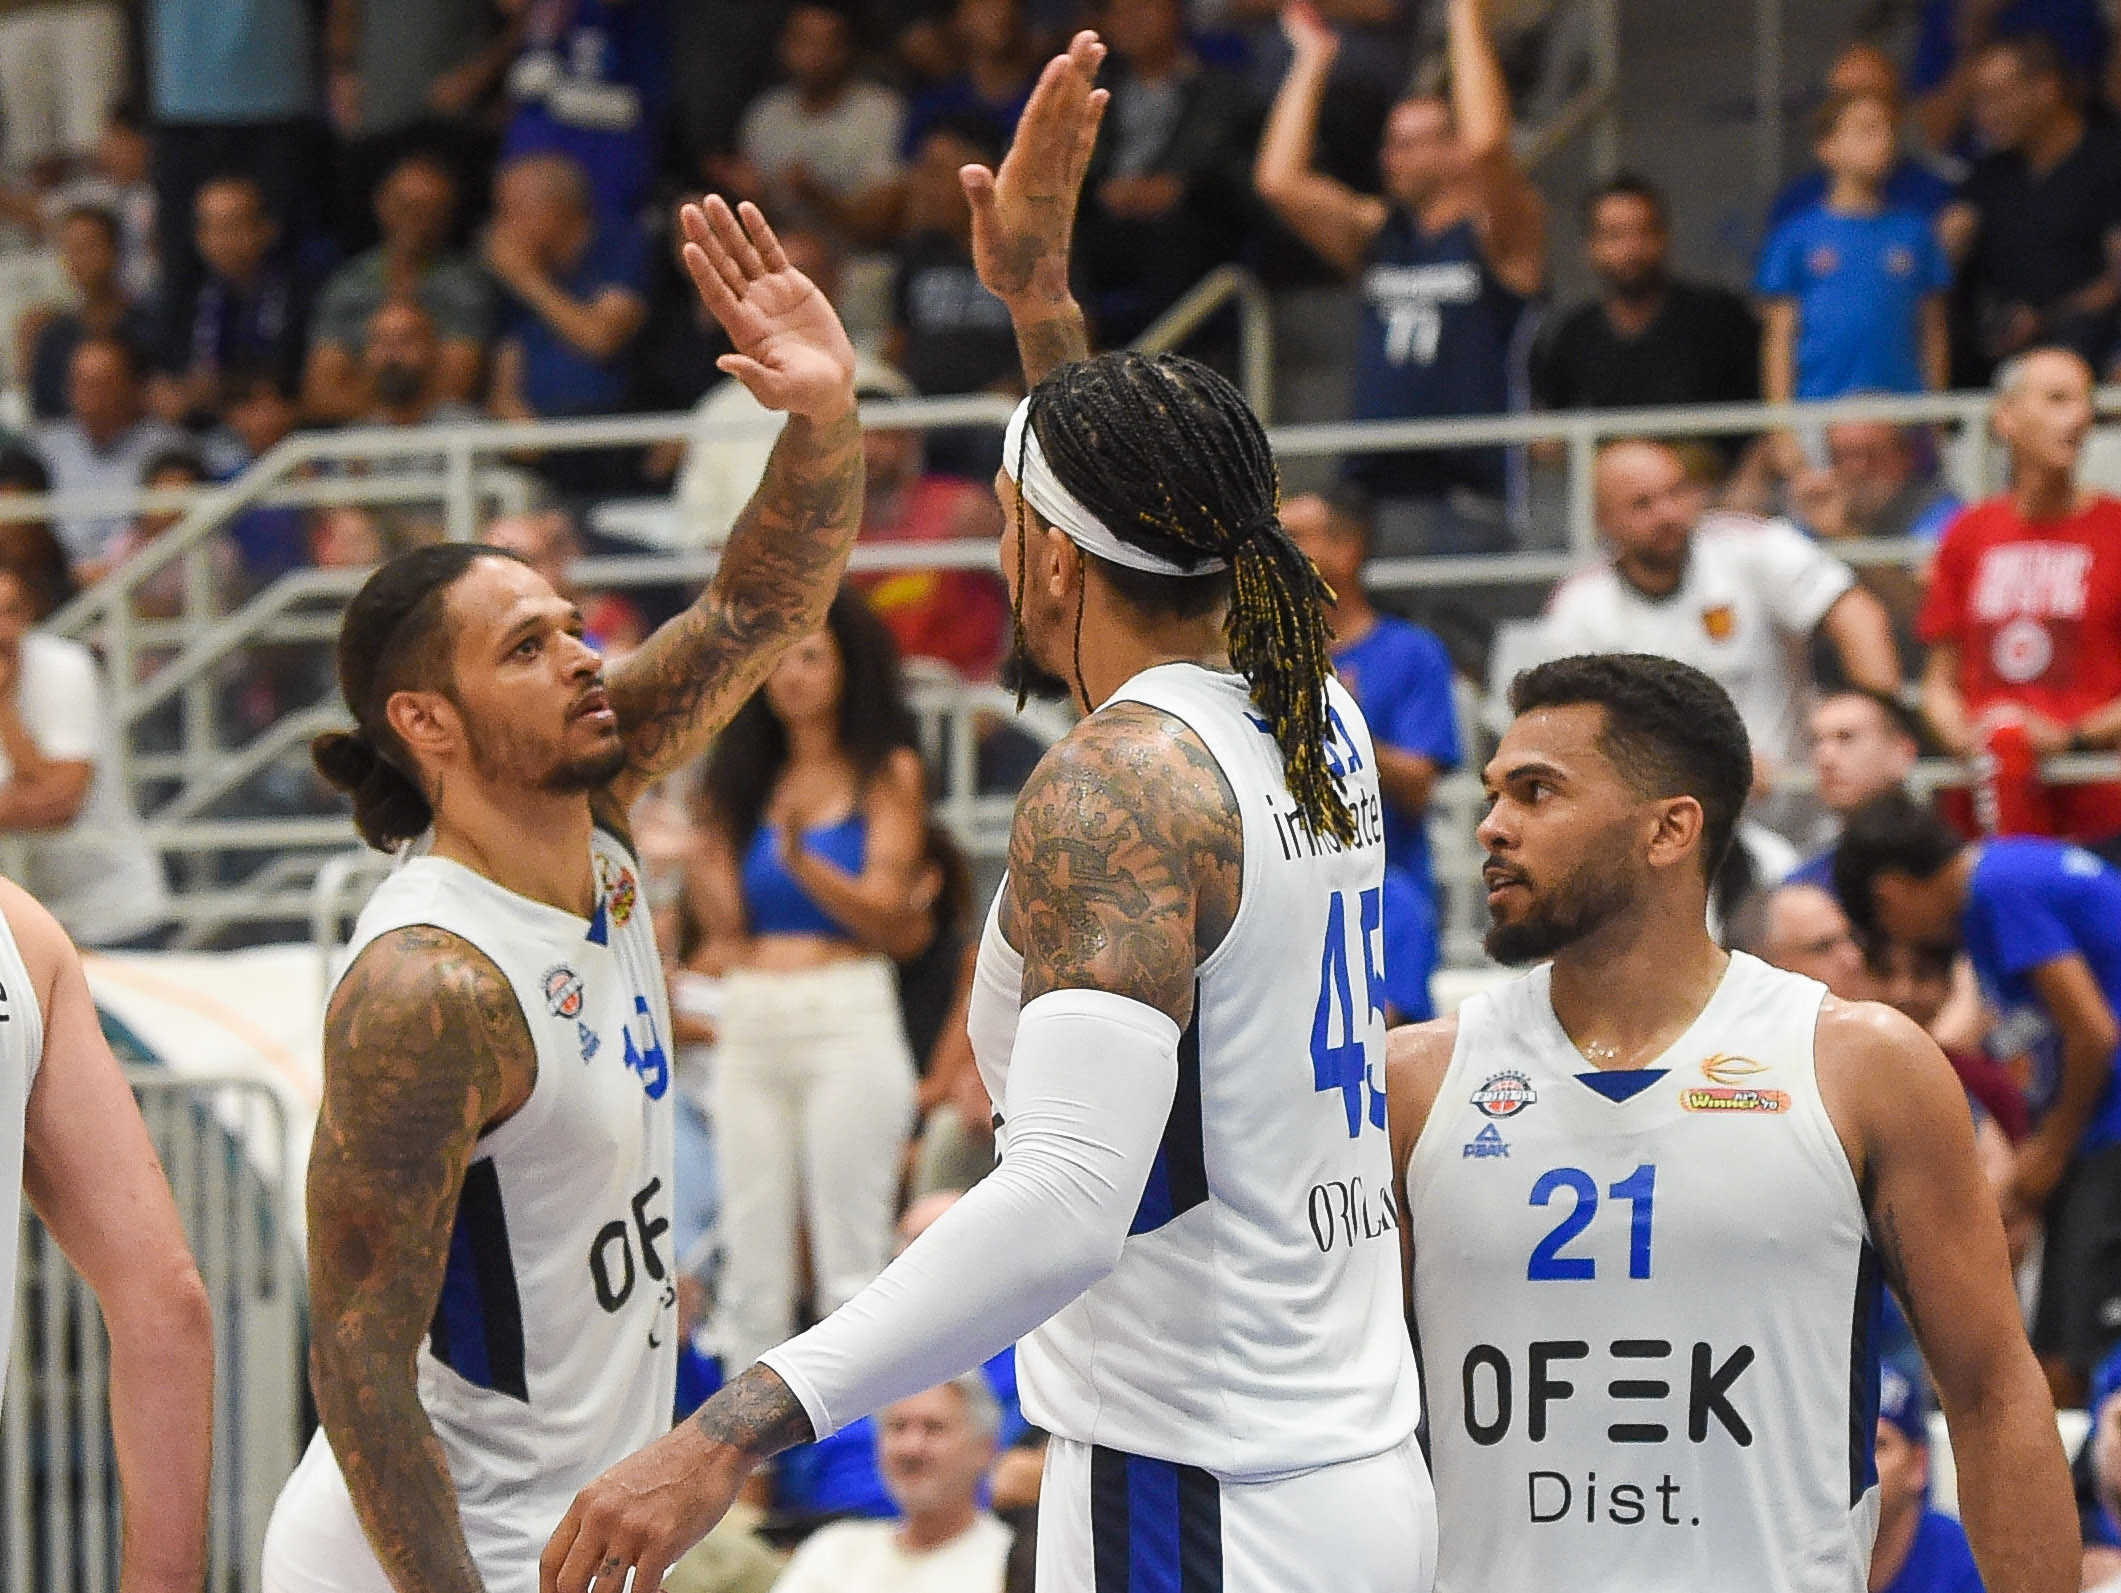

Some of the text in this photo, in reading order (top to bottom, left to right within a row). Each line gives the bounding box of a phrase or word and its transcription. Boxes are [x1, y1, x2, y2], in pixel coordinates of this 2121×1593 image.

[1690, 1093, 1759, 1109] Winner
[1463, 1143, 1511, 1159] PEAK
[1527, 1163, 1657, 1282] 21
[1461, 1338, 1756, 1448] OFEK
[1529, 1470, 1701, 1527] Dist.
